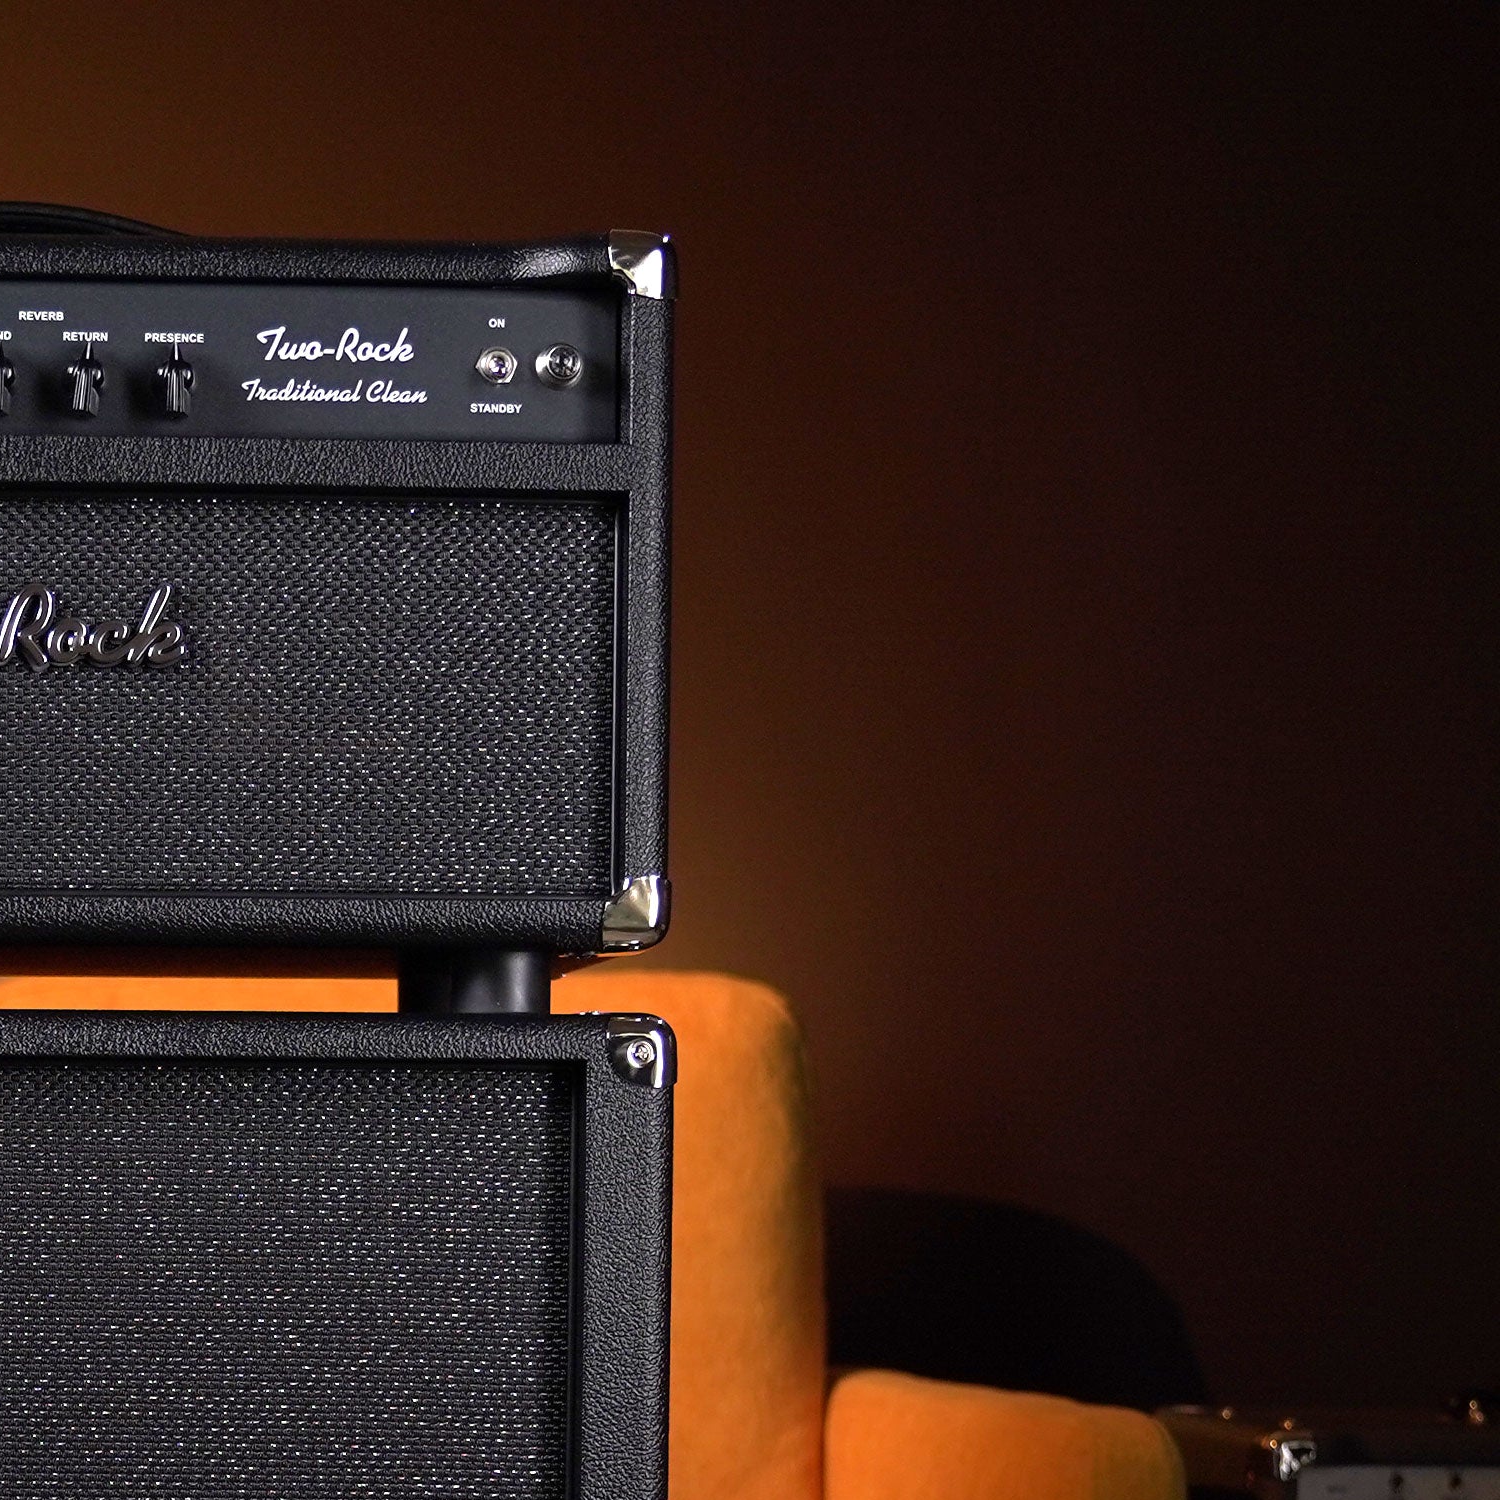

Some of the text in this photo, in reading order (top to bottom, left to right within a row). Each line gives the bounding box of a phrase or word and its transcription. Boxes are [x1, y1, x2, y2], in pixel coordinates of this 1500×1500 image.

[18, 310, 65, 321] REVERB
[488, 318, 506, 329] ON
[62, 331, 108, 342] RETURN
[144, 332, 205, 344] PRESENCE
[256, 326, 415, 363] Two-Rock
[241, 378, 428, 404] Traditional Clean
[470, 402, 523, 414] STANDBY
